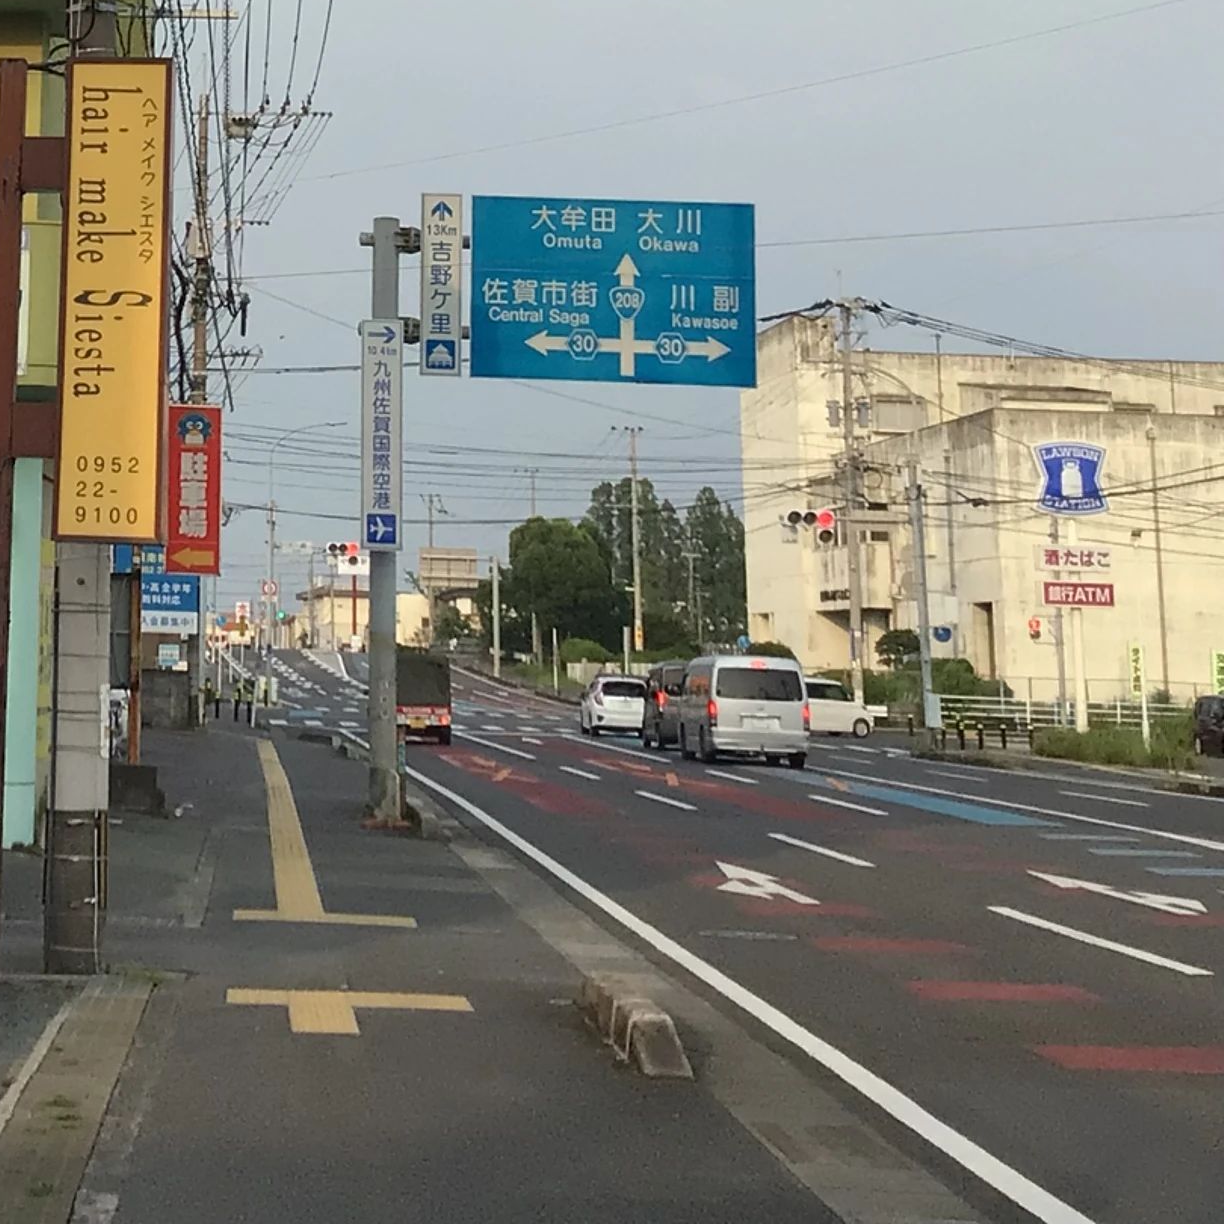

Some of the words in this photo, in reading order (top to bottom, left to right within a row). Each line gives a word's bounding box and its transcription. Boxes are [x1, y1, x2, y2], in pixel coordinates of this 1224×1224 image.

[79, 85, 143, 155] hair
[142, 99, 158, 128] ヘア
[140, 137, 157, 187] メイク
[76, 177, 137, 264] make
[139, 196, 155, 264] シエスタ
[426, 224, 457, 237] 13Km
[531, 205, 616, 233] 大牟田
[637, 208, 701, 236] 大川
[543, 233, 603, 249] Omuta
[639, 238, 699, 253] Okawa
[481, 277, 599, 309] 佐賀市街
[615, 291, 640, 309] 208
[670, 284, 740, 313] 川副
[488, 307, 544, 323] Central
[549, 309, 590, 326] Saga
[672, 315, 739, 331] Kawasoe
[73, 289, 153, 398] Siesta
[572, 336, 595, 353] 30
[659, 339, 682, 357] 30
[372, 360, 392, 510] 九州佐賀国際空港
[1041, 447, 1100, 462] LAWSON
[76, 456, 140, 474] 0952
[76, 481, 118, 497] 22-
[1043, 494, 1101, 510] STATION
[75, 507, 139, 524] 9100
[1044, 548, 1111, 568] 酒・たばこ
